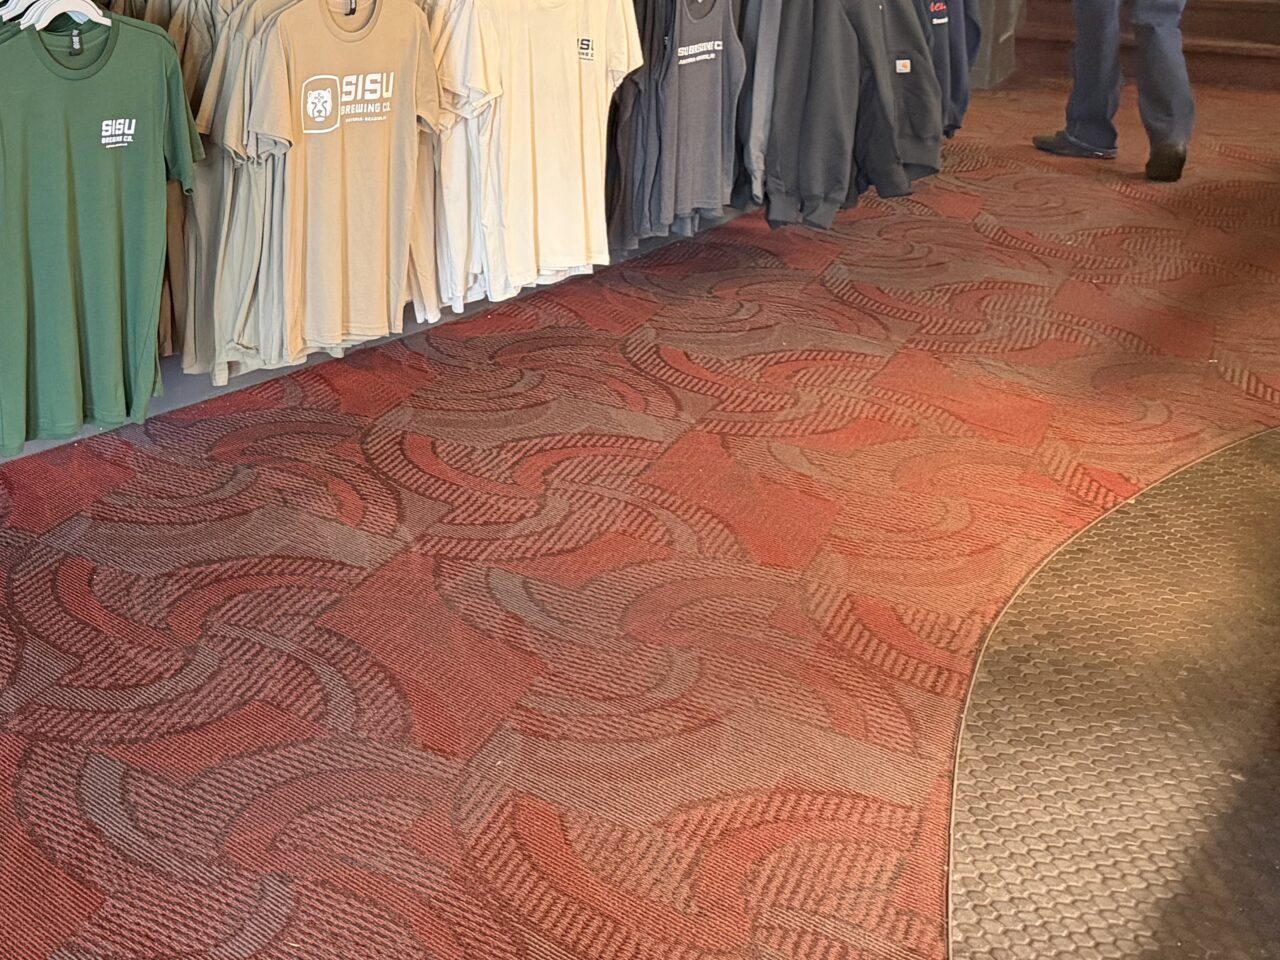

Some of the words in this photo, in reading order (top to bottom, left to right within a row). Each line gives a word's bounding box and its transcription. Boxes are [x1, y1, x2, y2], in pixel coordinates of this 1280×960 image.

[341, 72, 394, 102] SISU
[340, 102, 381, 116] BREWING
[101, 119, 136, 136] SISU
